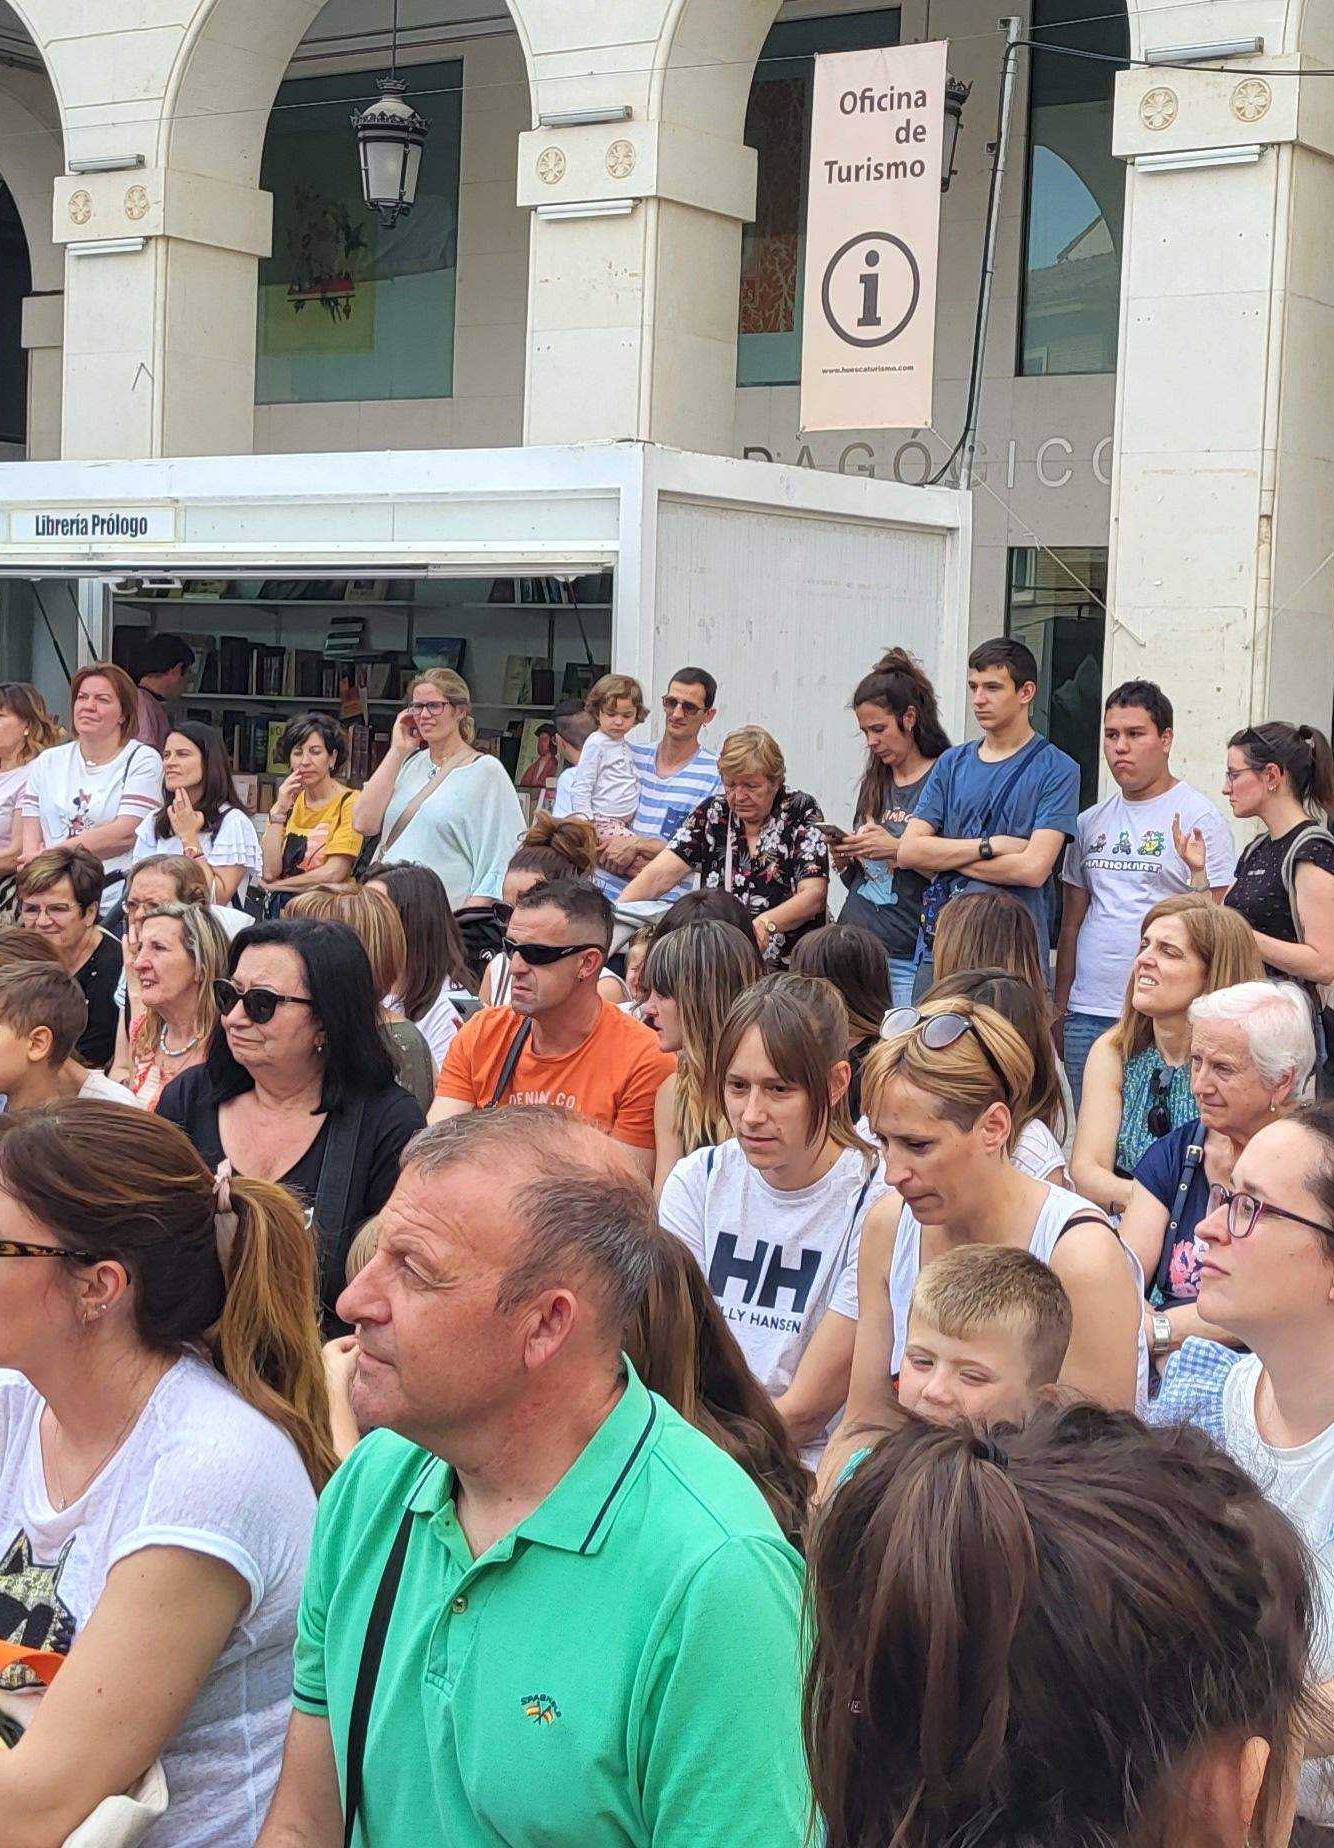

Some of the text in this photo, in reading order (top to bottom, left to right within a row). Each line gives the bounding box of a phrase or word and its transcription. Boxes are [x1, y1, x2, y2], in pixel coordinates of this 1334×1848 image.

[839, 86, 928, 115] Oficina
[895, 118, 927, 144] de
[824, 157, 926, 184] Turismo
[821, 363, 915, 375] www.huescaturismo.com
[35, 512, 148, 538] Librería Prólogo
[709, 1231, 823, 1314] HH
[750, 1312, 801, 1334] HANSEN
